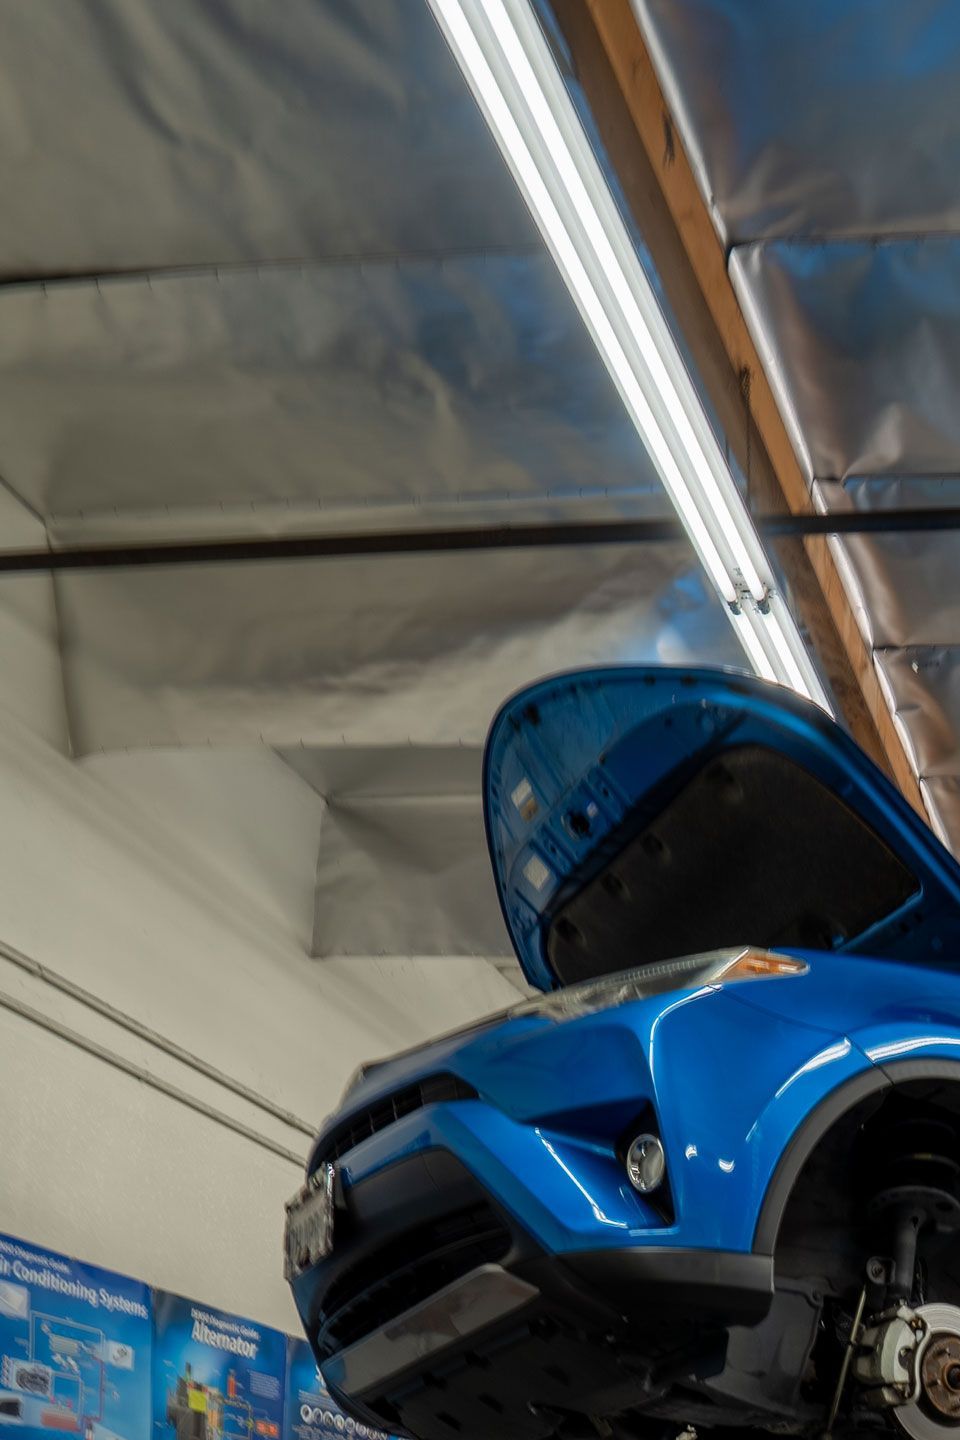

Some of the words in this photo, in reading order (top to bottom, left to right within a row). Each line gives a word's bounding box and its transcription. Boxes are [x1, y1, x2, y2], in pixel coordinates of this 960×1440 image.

[13, 1260, 100, 1309] Conditioning
[99, 1287, 149, 1320] Systems
[192, 1320, 258, 1360] Alternator
